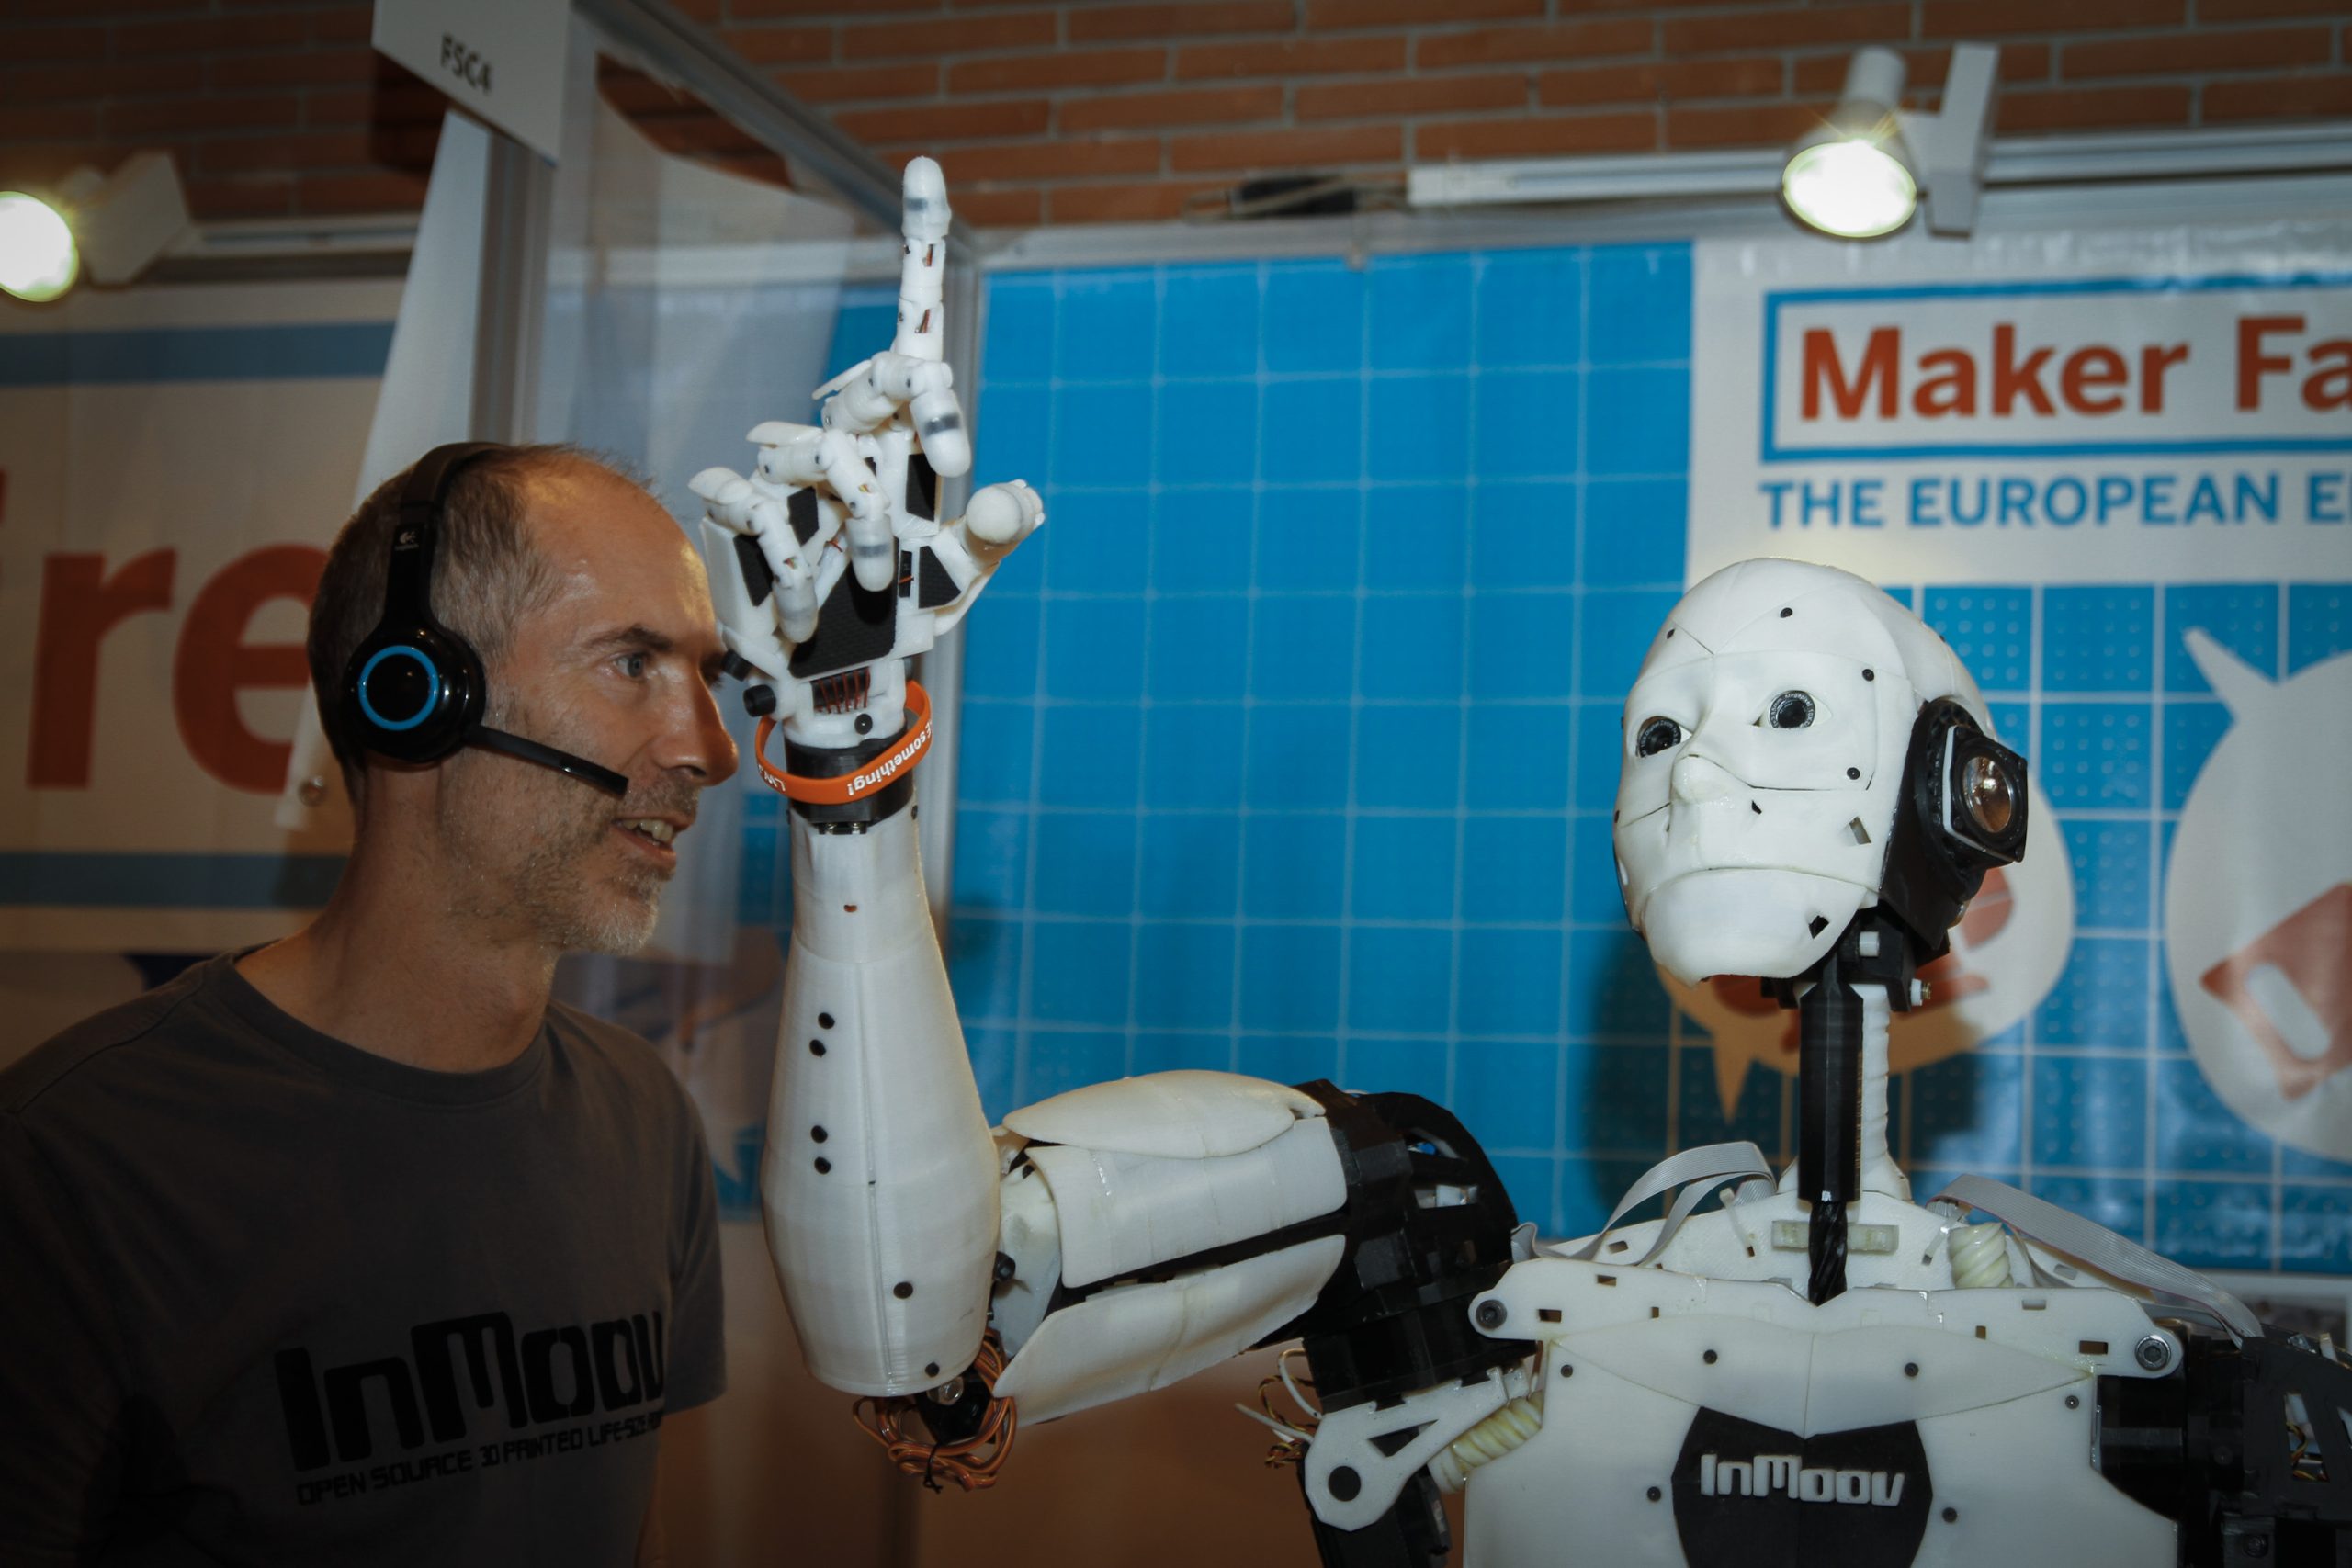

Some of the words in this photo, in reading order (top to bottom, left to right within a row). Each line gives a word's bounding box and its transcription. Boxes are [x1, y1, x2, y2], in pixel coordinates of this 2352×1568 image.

[441, 34, 492, 95] FSC4
[1801, 322, 2191, 422] Maker
[1758, 478, 1886, 529] THE
[1907, 472, 2279, 528] EUROPEAN
[2307, 473, 2352, 525] E
[0, 468, 334, 796] re
[846, 731, 927, 796] something!
[274, 1311, 663, 1472] InMoov
[296, 1472, 366, 1506] OPEN
[371, 1450, 472, 1491] SOURCE
[1700, 1452, 1906, 1506] InMoov
